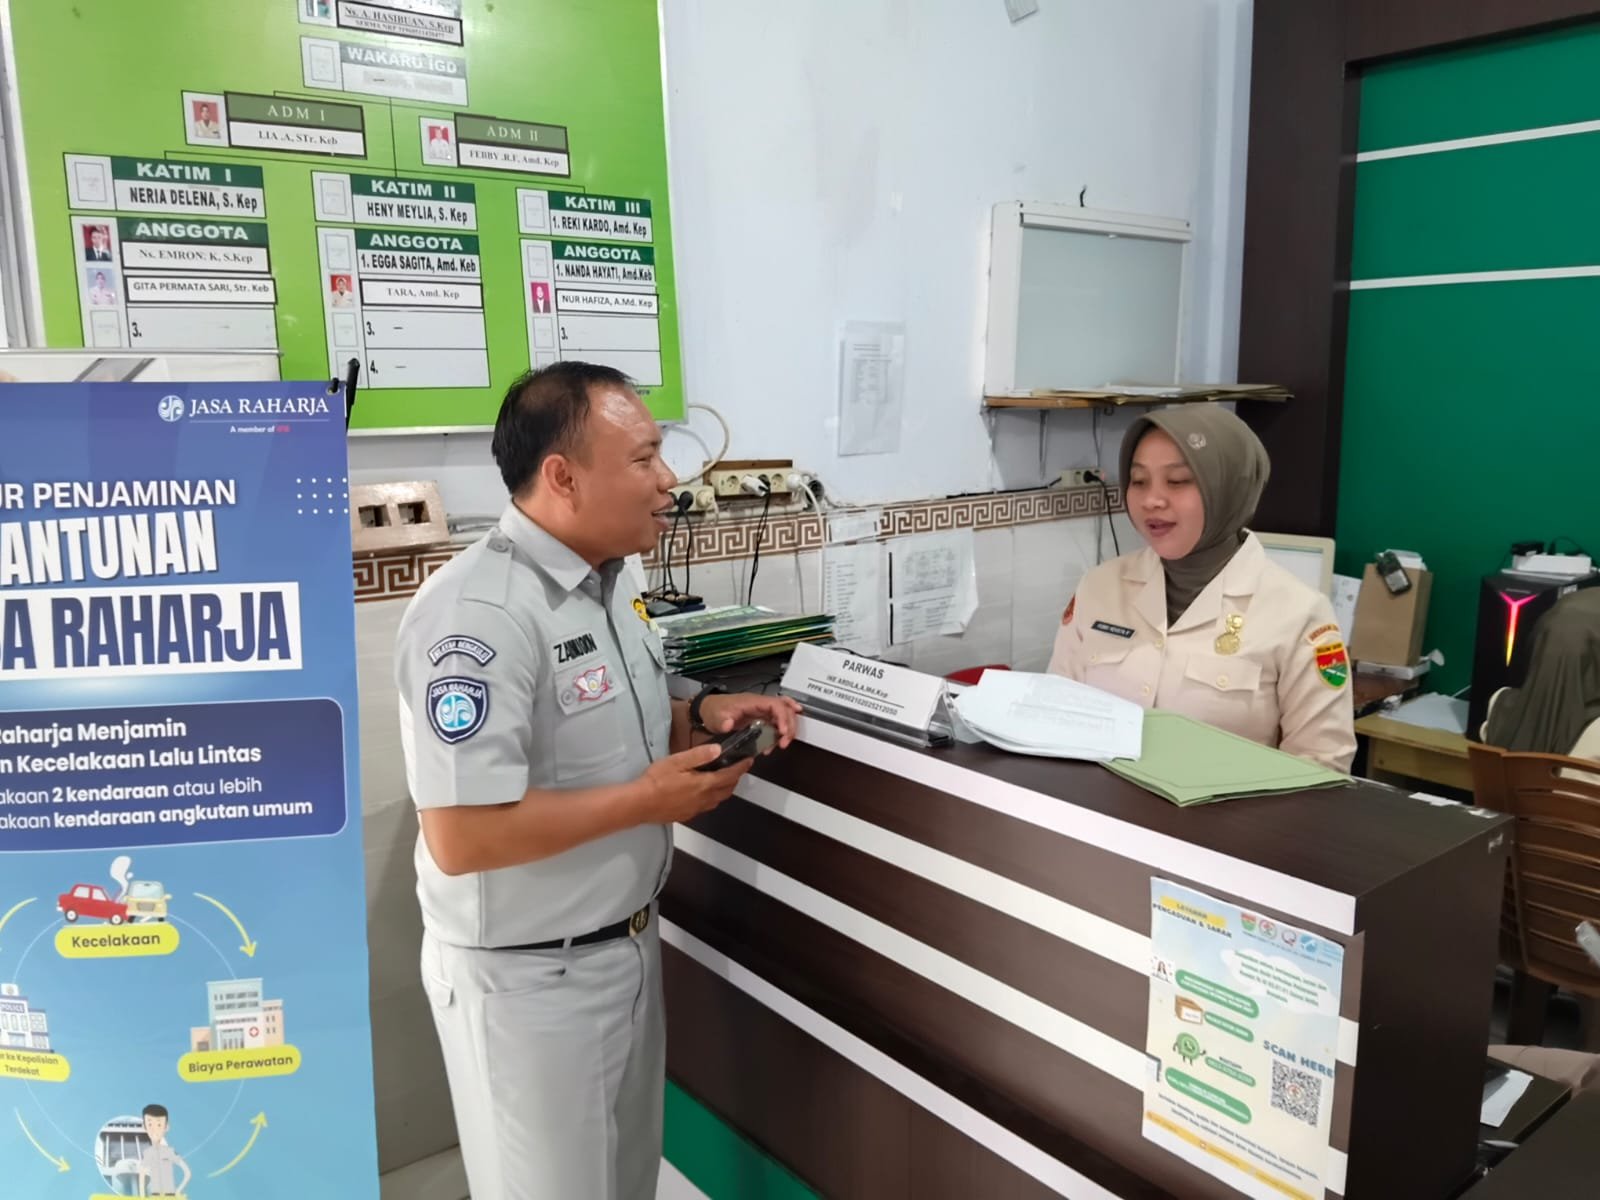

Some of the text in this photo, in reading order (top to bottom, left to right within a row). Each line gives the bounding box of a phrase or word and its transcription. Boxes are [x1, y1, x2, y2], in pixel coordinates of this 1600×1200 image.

[347, 46, 458, 73] WAKARU IGD
[267, 104, 325, 122] ADM I
[258, 130, 278, 141] LIA
[487, 125, 539, 142] ADM II
[136, 162, 232, 183] KATIM I
[370, 179, 457, 199] KATIM II
[129, 187, 258, 213] NERIA DELENA, S. Kep
[564, 195, 641, 214] KATIM III
[367, 202, 468, 225] HENY MEYLIA, S. Kep
[135, 222, 249, 241] ANGGOTA
[552, 216, 647, 239] 1. REKI KARDO, Amd. Kep
[369, 233, 463, 251] ANGGOTA
[223, 253, 253, 265] S.Kep
[360, 253, 476, 273] 1. EGGA SAGITA, Amd. Keb
[563, 245, 641, 262] ANGGOTA
[556, 264, 563, 277] 1.
[564, 265, 591, 278] NANDA
[592, 266, 621, 282] HAYATI,
[133, 281, 270, 293] GITA PERMATA SARI, Str. Keb
[386, 287, 460, 299] TARA, Amd. Kep
[562, 294, 580, 303] NUR
[581, 295, 613, 306] HAFIZA,
[638, 299, 653, 308] Kep
[131, 321, 142, 338] 3.
[366, 321, 375, 336] 3.
[561, 326, 569, 340] 3.
[369, 360, 379, 374] 4.
[189, 397, 329, 418] JASA RAHARJA
[230, 425, 237, 433] A
[237, 425, 266, 433] member
[267, 424, 275, 433] of
[33, 479, 236, 509] PENJAMINAN
[51, 591, 292, 668] RAHARJA
[842, 659, 885, 679] PARWAS
[0, 717, 187, 748] aharja Menjamin
[17, 750, 145, 773] Kecelakaan
[149, 748, 194, 767] Lalu
[198, 745, 262, 766] Lintas
[52, 786, 63, 803] 2
[66, 783, 169, 803] kendaraan
[173, 781, 215, 797] atau
[219, 776, 262, 795] lebih
[54, 810, 156, 828] kendaraan
[158, 803, 249, 826] angkutan
[252, 800, 313, 818] umum
[71, 932, 161, 949] Kecelakaan
[16, 1053, 59, 1066] Kepolisian
[188, 1055, 294, 1075] Biaya Perawatan
[1263, 1040, 1297, 1063] SCAN
[1300, 1056, 1334, 1079] HERE
[4, 1065, 40, 1076] Terdekat
